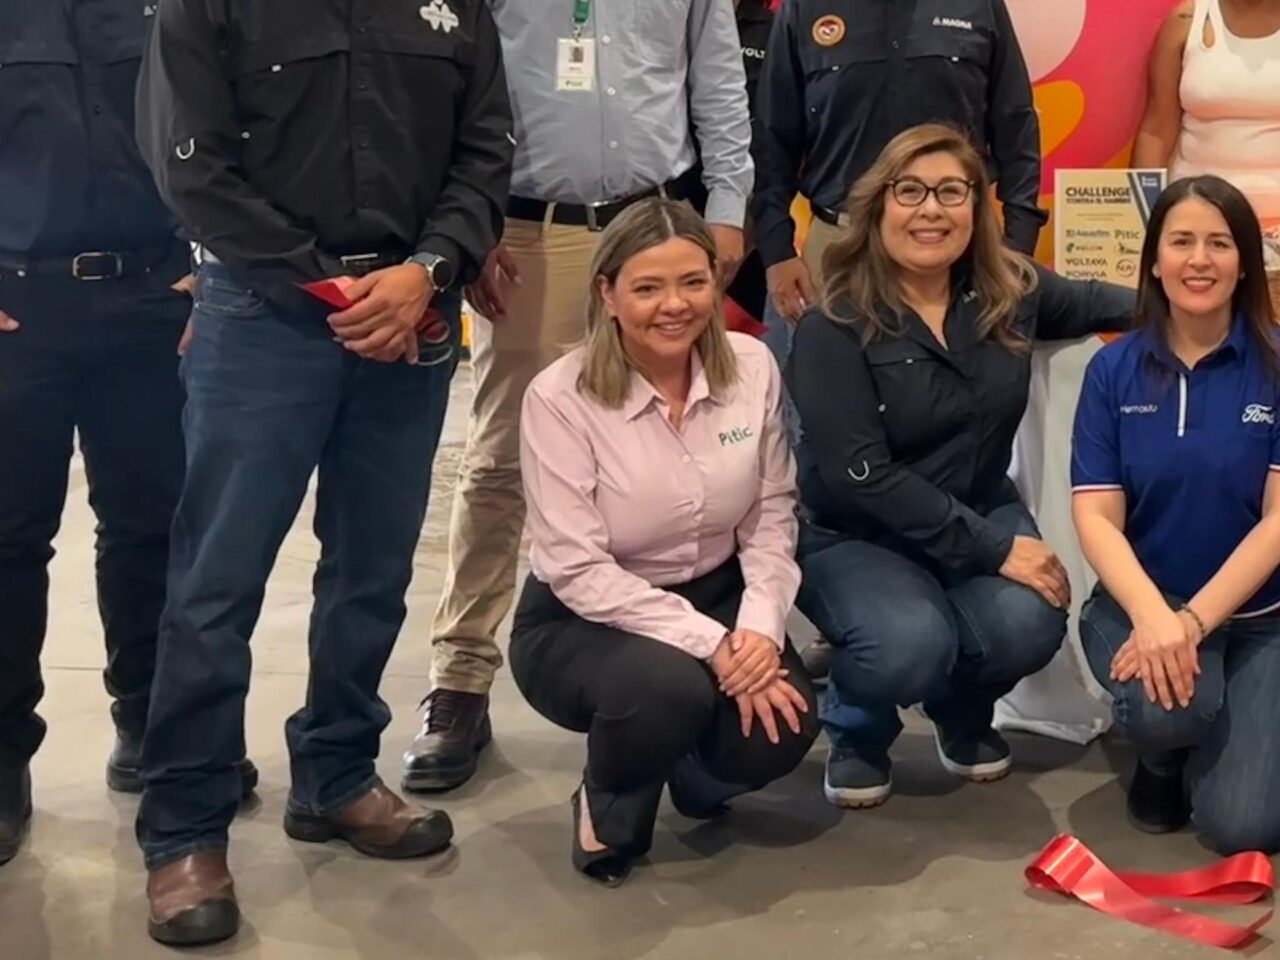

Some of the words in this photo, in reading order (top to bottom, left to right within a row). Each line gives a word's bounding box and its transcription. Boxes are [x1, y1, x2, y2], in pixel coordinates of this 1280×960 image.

[1065, 186, 1131, 197] CHALLENGE
[1114, 229, 1140, 240] Pitic
[719, 426, 753, 446] Pitic
